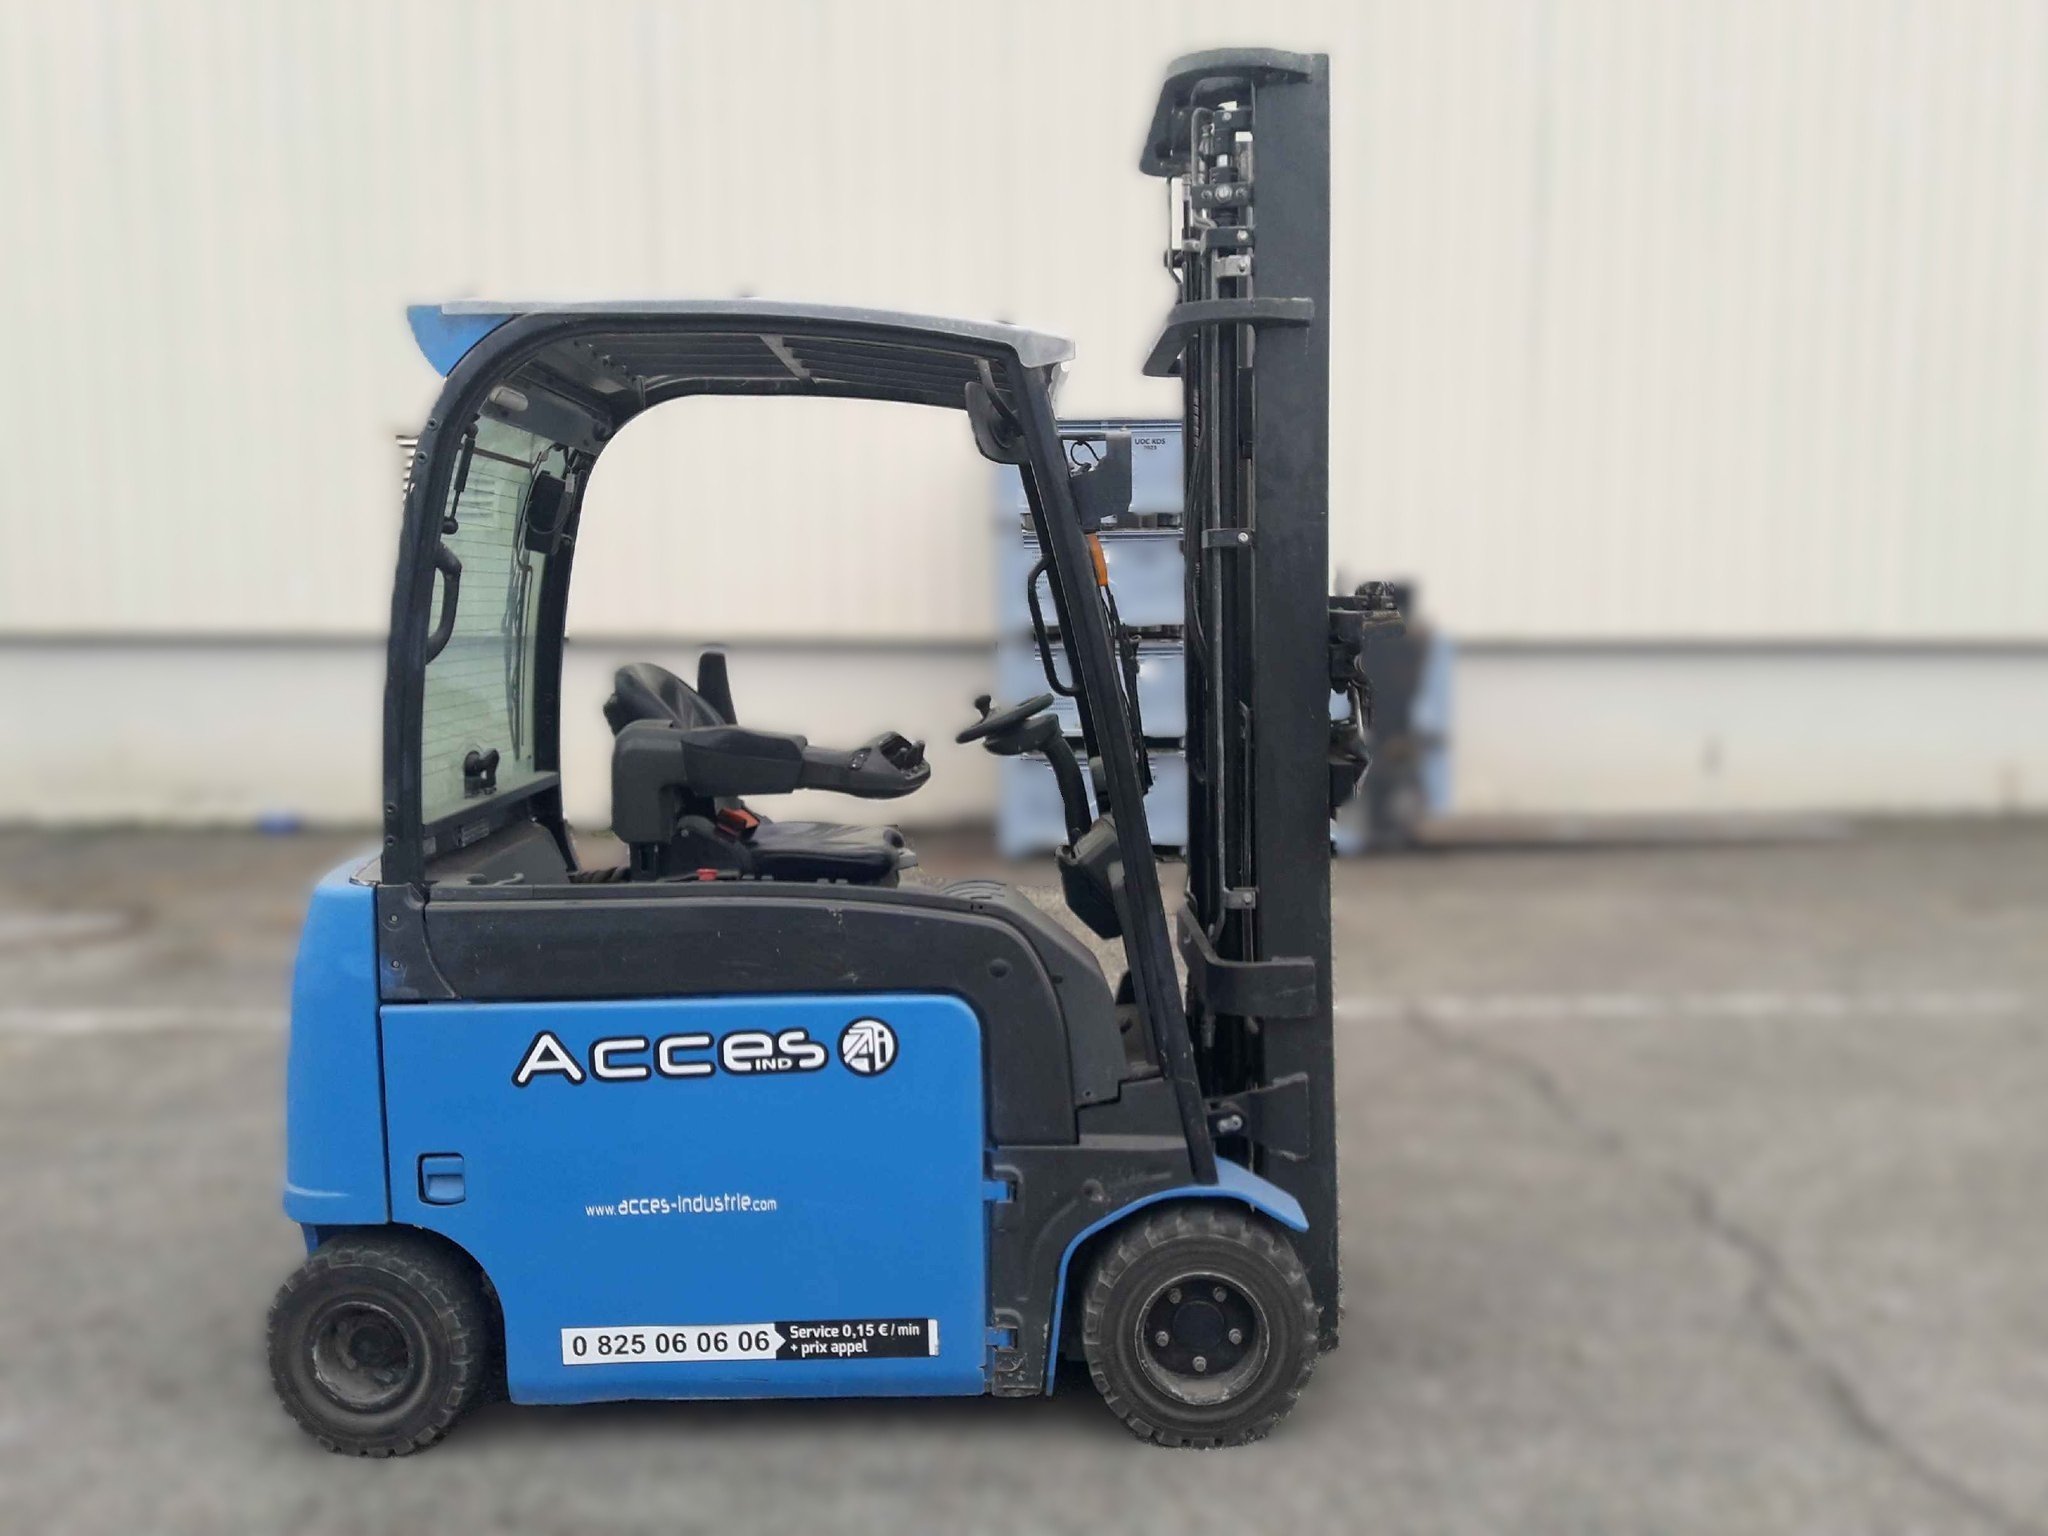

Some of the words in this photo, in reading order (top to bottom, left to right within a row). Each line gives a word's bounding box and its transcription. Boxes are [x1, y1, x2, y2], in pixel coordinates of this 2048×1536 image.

[755, 1057, 792, 1072] IND
[585, 1192, 777, 1217] www.acces-industrie.com
[789, 1325, 838, 1339] Service
[842, 1323, 874, 1339] 0,15
[572, 1336, 587, 1356] 0
[598, 1334, 646, 1355] 825
[655, 1333, 687, 1354] 06
[697, 1332, 728, 1353] 06
[738, 1331, 770, 1352] 06
[801, 1340, 827, 1358] prix
[831, 1338, 868, 1357] appel
